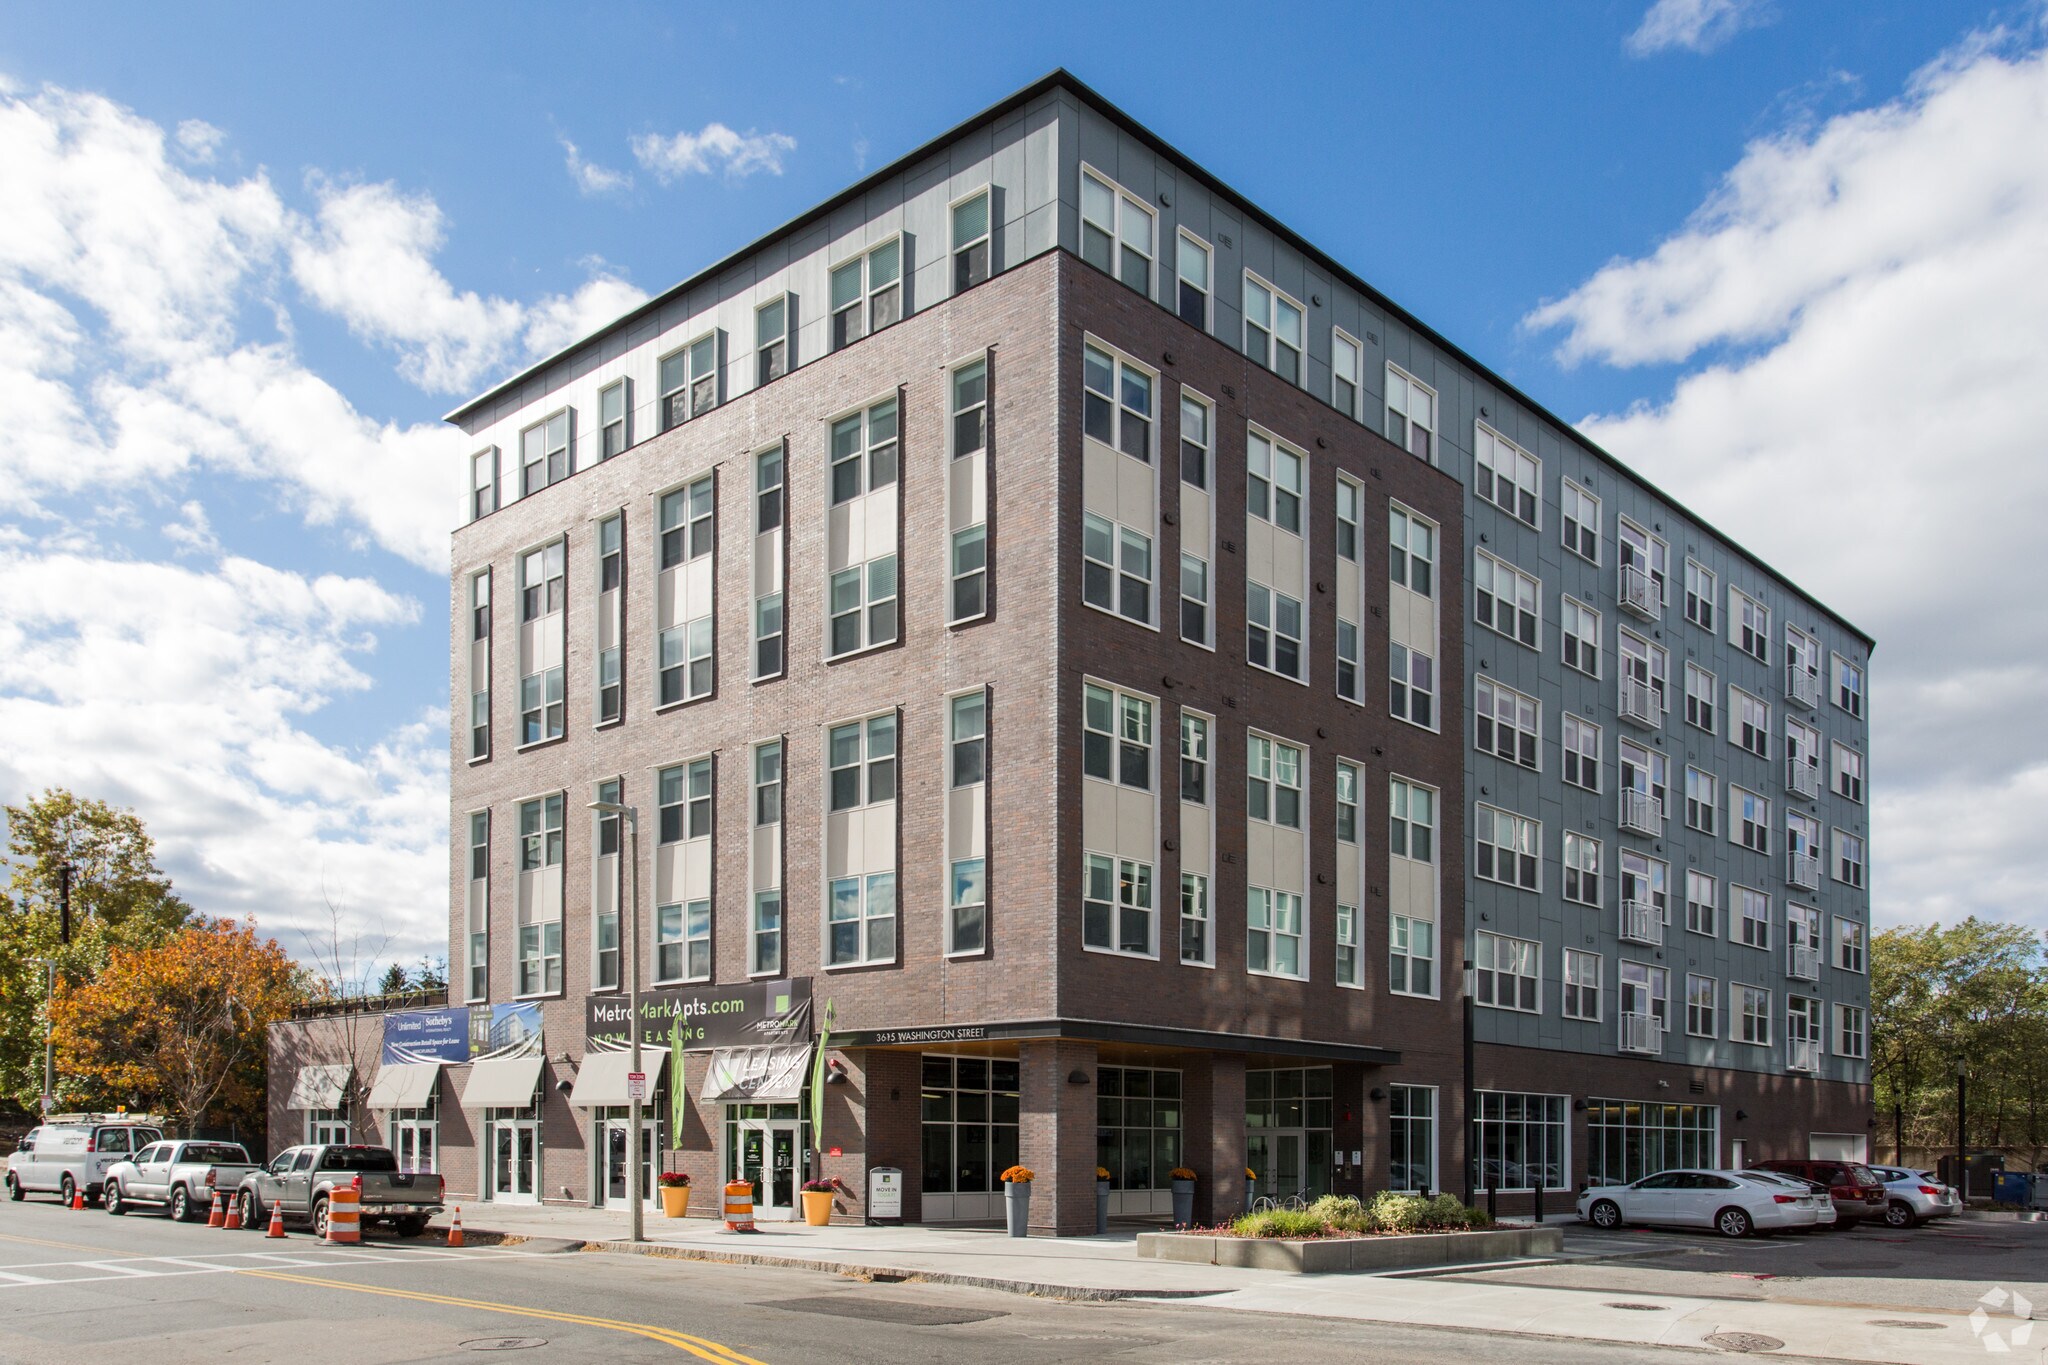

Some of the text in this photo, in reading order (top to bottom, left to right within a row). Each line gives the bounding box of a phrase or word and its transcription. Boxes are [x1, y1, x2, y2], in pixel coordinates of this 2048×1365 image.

[398, 1021, 421, 1031] Unlimited
[425, 1015, 453, 1027] Sotheby's
[756, 1020, 798, 1029] METROMARK
[645, 1027, 705, 1043] EASNG
[876, 1027, 984, 1042] 3615 WASHINGTON STREET
[743, 1056, 800, 1071] LEASING
